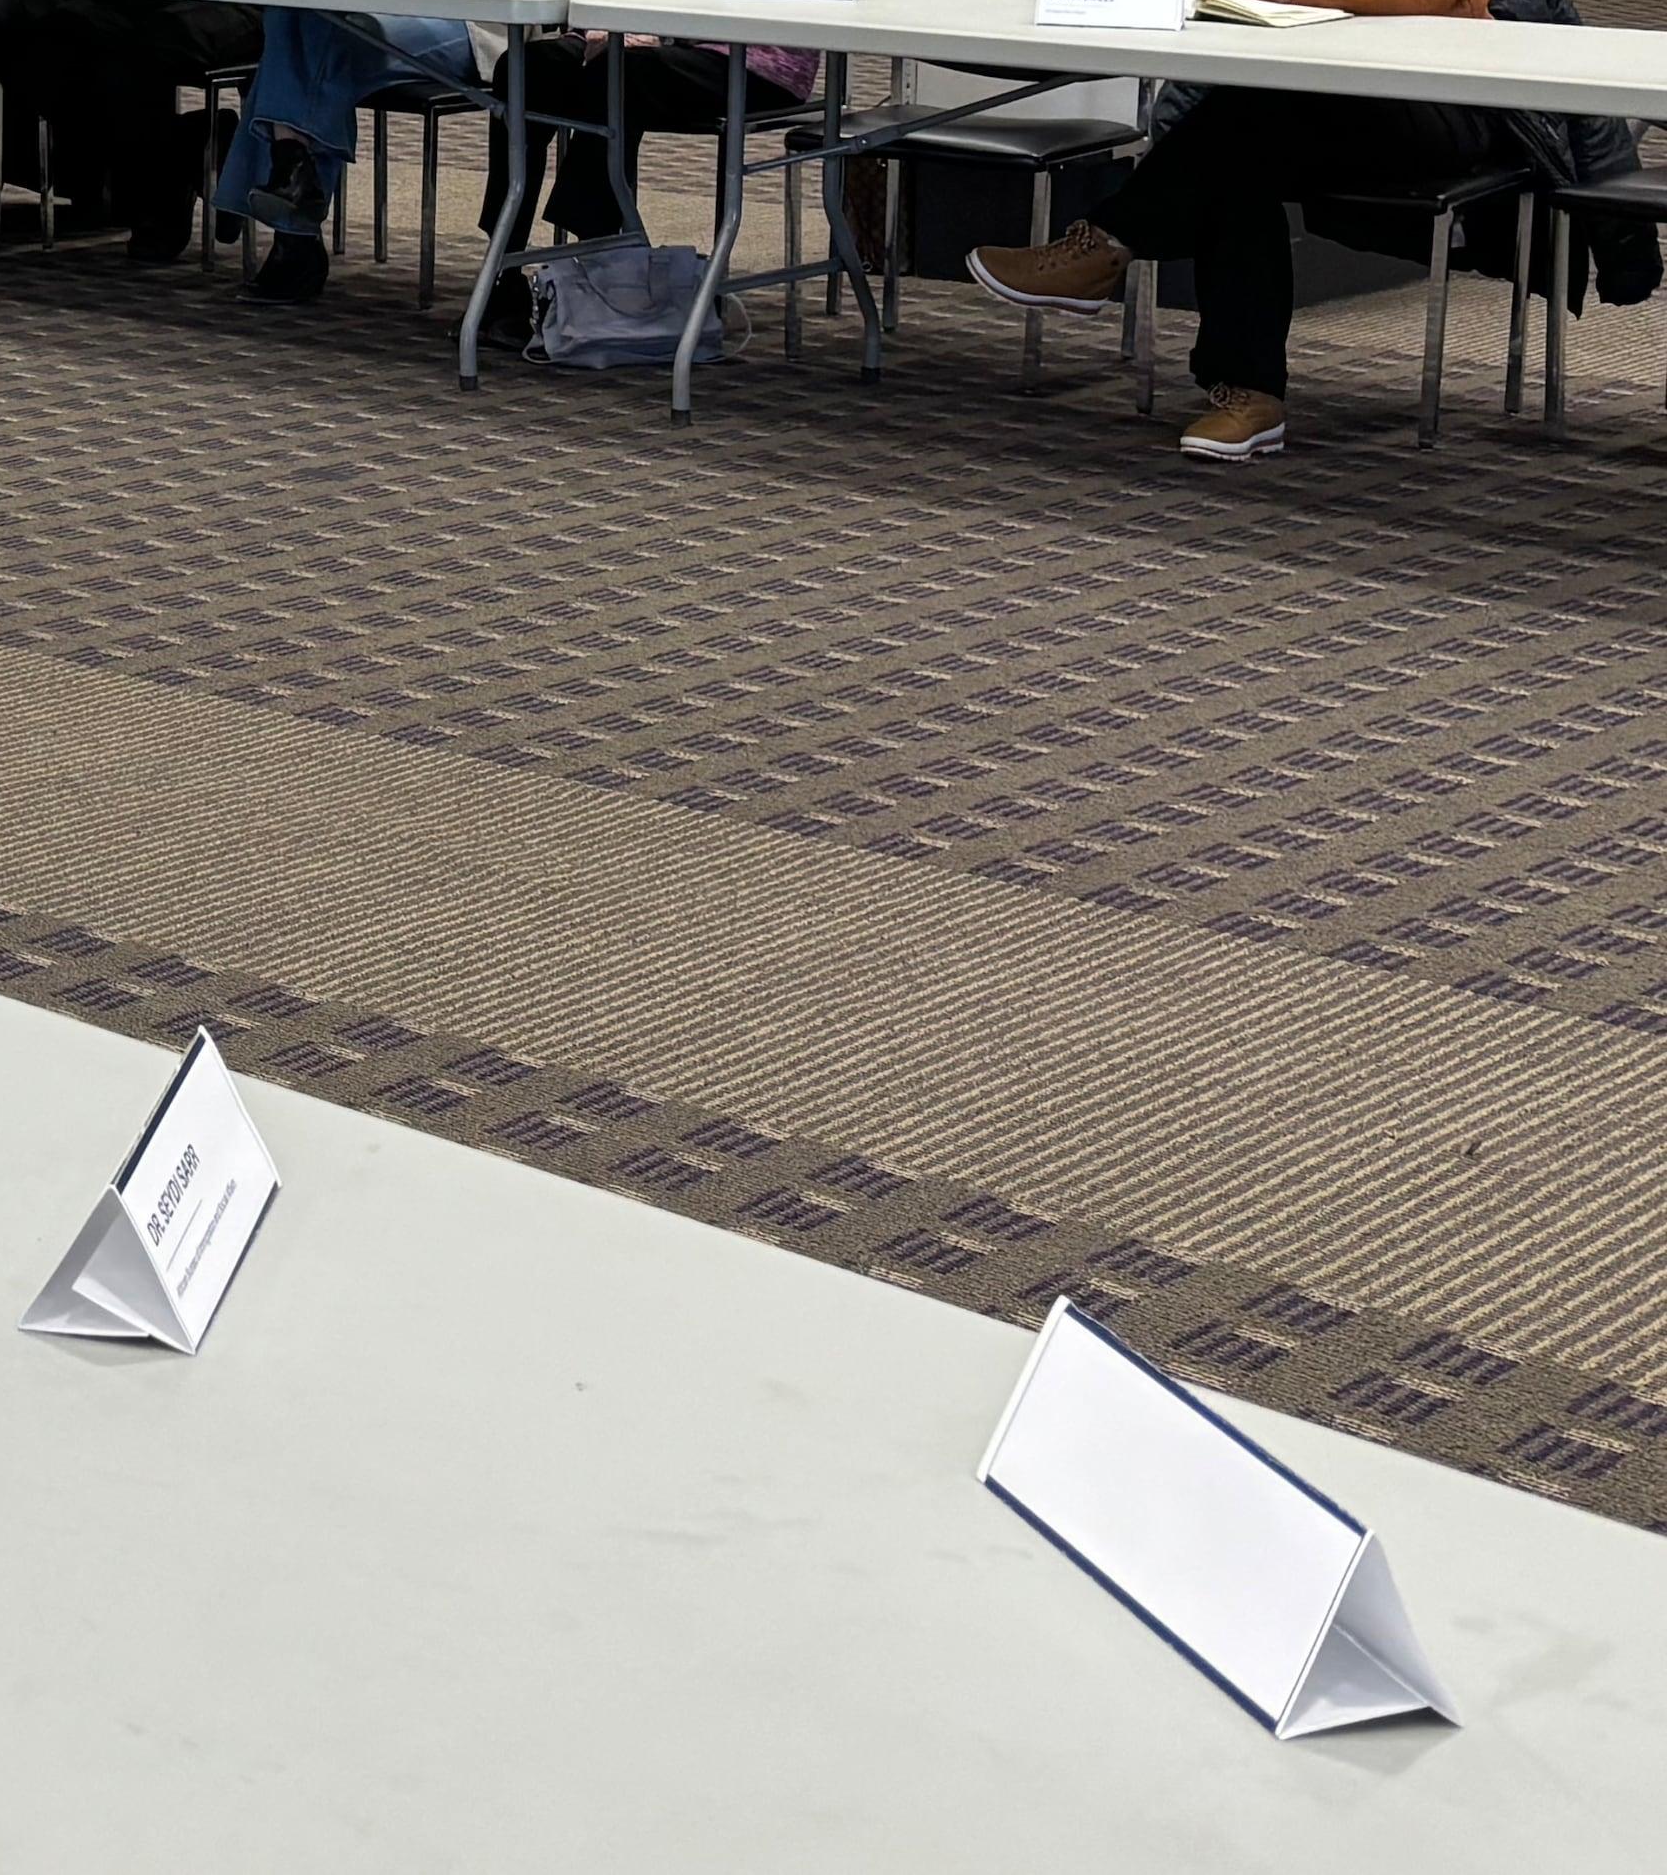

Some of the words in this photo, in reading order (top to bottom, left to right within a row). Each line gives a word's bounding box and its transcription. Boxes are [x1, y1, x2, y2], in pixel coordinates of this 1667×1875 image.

[147, 1213, 166, 1247] DR.
[157, 1173, 184, 1225] SEYDI
[176, 1143, 200, 1190] SARR
